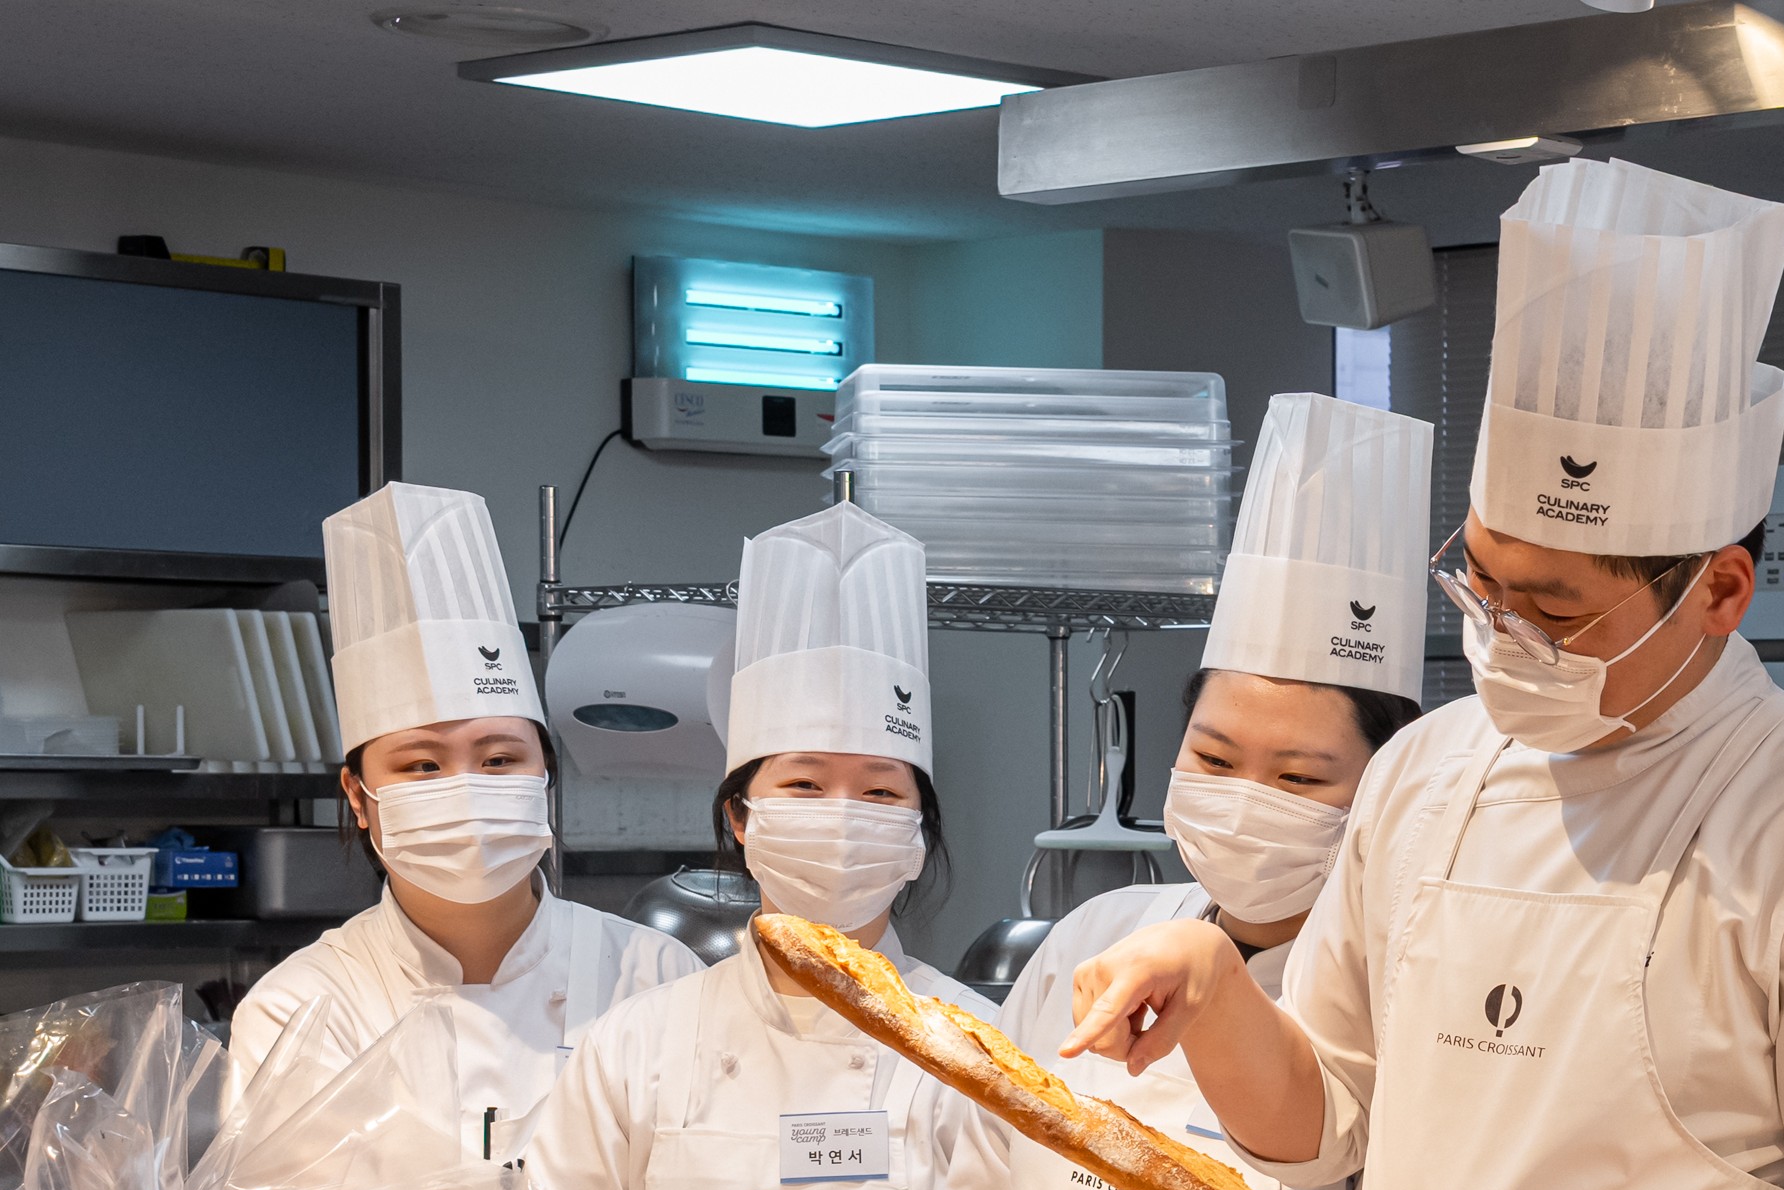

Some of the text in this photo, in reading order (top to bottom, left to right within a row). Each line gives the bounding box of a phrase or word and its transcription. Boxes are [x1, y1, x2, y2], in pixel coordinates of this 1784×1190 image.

[1561, 479, 1590, 492] SPC
[1537, 494, 1610, 514] CULINARY
[1536, 506, 1608, 526] ACADEMY
[1351, 621, 1372, 632] SPC
[1330, 636, 1385, 653] CULINARY
[1329, 647, 1384, 664] ACADEMY
[485, 662, 502, 670] SPC
[473, 677, 516, 686] CULINARY
[476, 687, 519, 695] ACADEMY
[897, 702, 911, 714] SPC
[885, 714, 920, 734] CULINARY
[886, 724, 921, 743] ACADEMY
[1437, 1032, 1546, 1058] PARIS CROISSANT
[791, 1127, 826, 1141] young
[796, 1135, 826, 1146] camp
[808, 1148, 863, 1166] 박연서
[1070, 1170, 1103, 1190] PARIS
